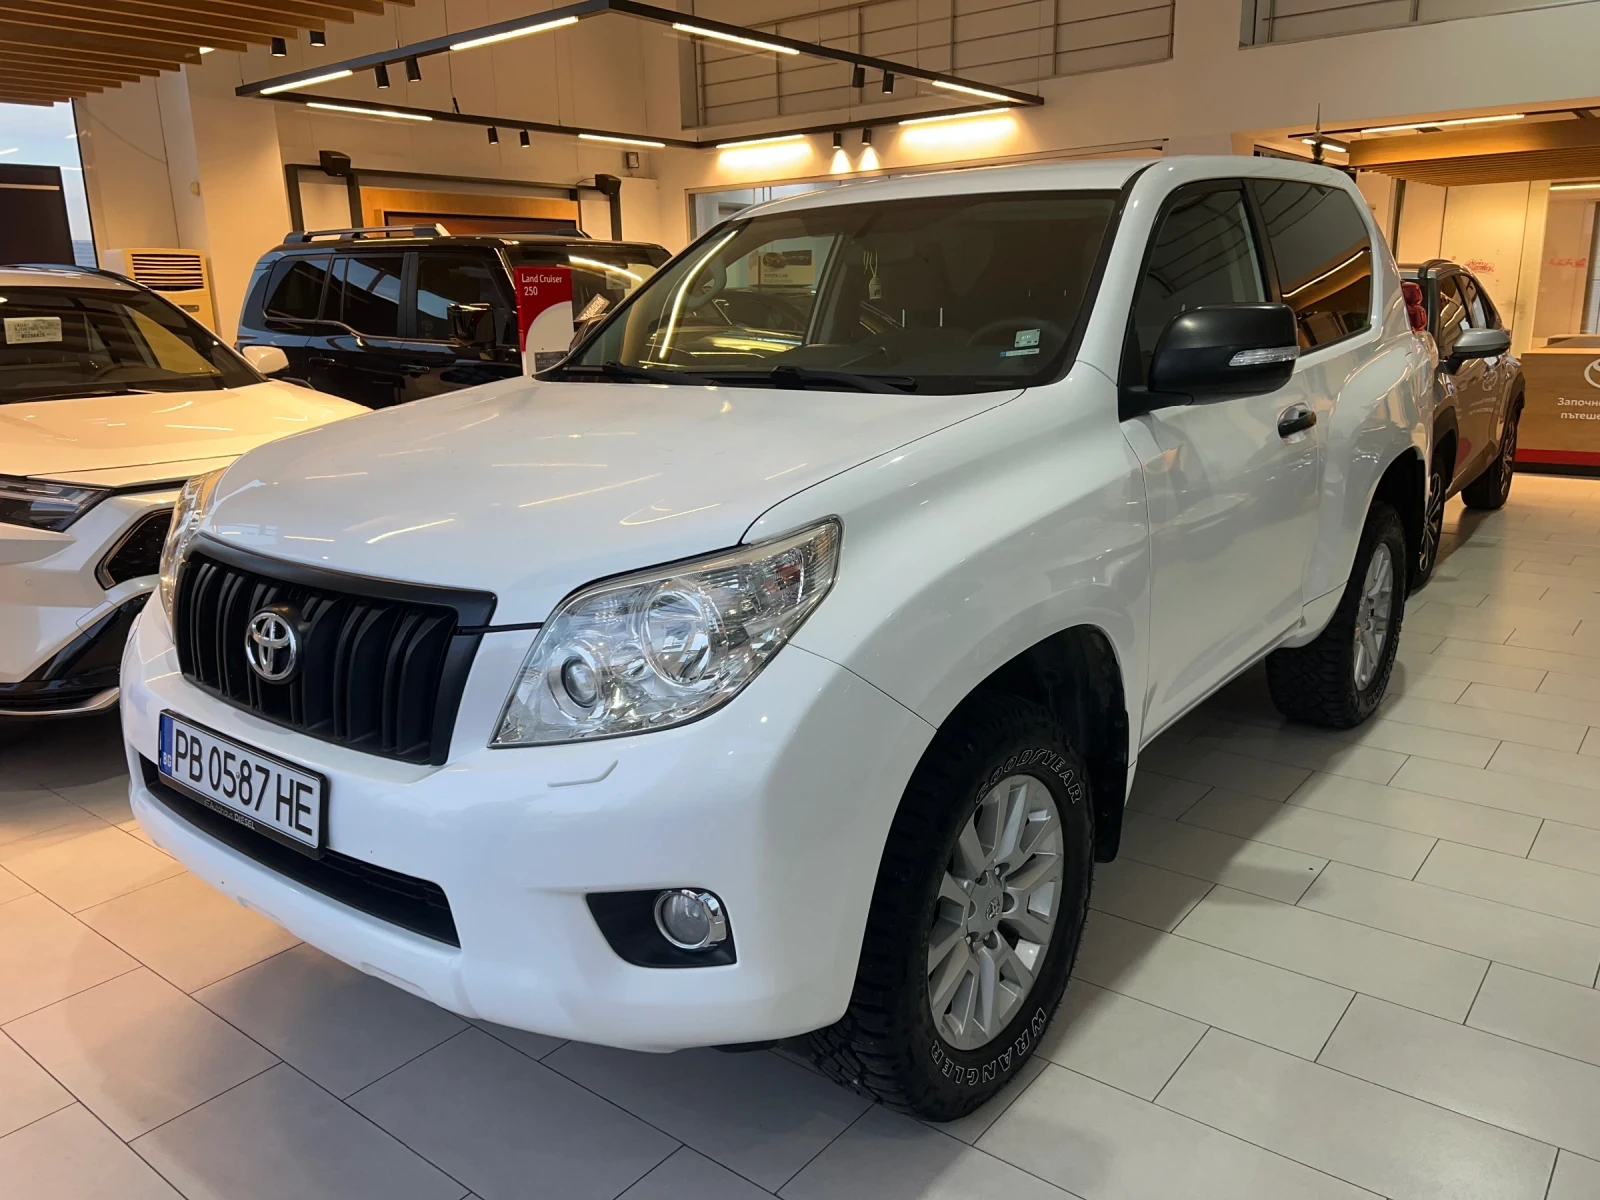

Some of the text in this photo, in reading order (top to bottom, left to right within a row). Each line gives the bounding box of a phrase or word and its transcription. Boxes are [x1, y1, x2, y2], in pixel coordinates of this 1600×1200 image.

[521, 273, 563, 284] Land Cruiser
[524, 286, 538, 296] 250
[1557, 397, 1600, 407] Започн
[163, 752, 172, 767] BG
[175, 728, 313, 837] PB 0587 HE
[976, 748, 1082, 804] GOODYEAR
[233, 812, 256, 830] DIESEL
[930, 1007, 1047, 1086] WRANGLER
